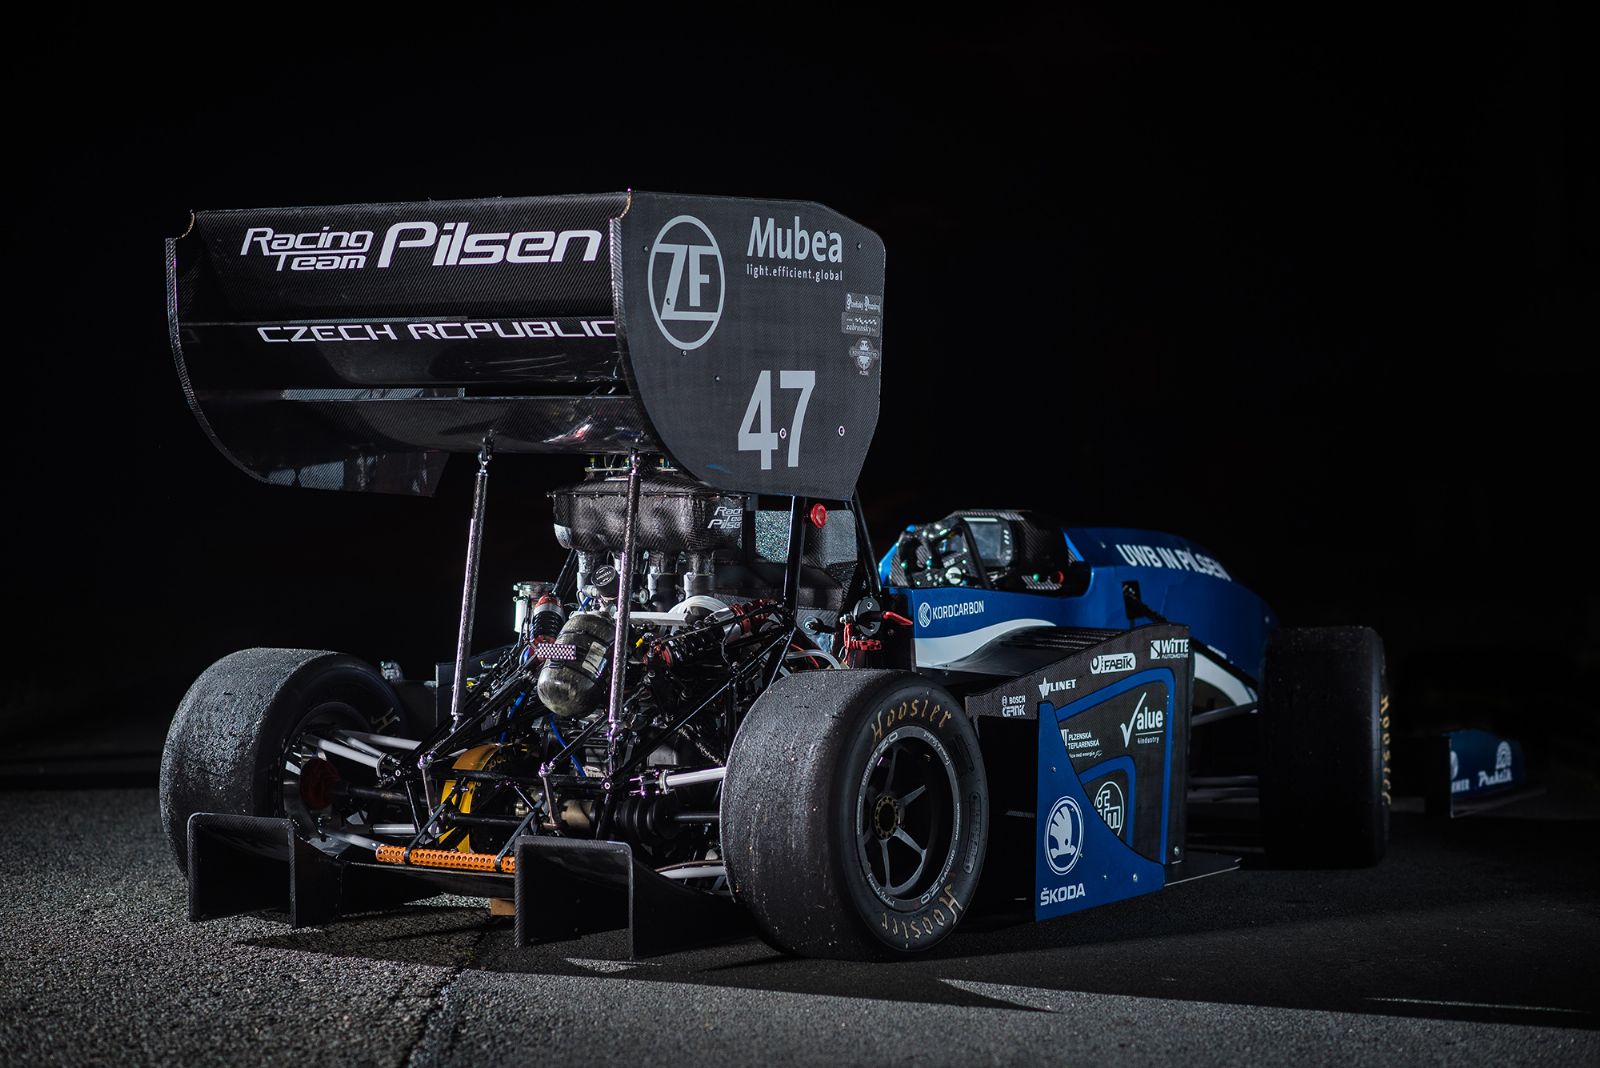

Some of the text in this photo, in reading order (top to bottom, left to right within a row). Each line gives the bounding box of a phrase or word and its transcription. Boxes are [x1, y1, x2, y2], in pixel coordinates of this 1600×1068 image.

[240, 226, 374, 256] Racing
[377, 221, 602, 268] Pilsen
[747, 216, 843, 263] Mubea
[276, 253, 366, 271] Team
[747, 264, 843, 282] light.efficient.global
[257, 324, 398, 342] CZECH
[737, 370, 816, 470] 47
[1115, 544, 1232, 583] UWB IN PILSEN
[932, 600, 985, 620] KORDCARBON
[1049, 678, 1077, 692] LINET
[1009, 695, 1026, 704] BOSCH
[871, 690, 952, 749] Hoosier
[1040, 883, 1086, 906] ŠKODA
[881, 883, 964, 949] Hoosier
